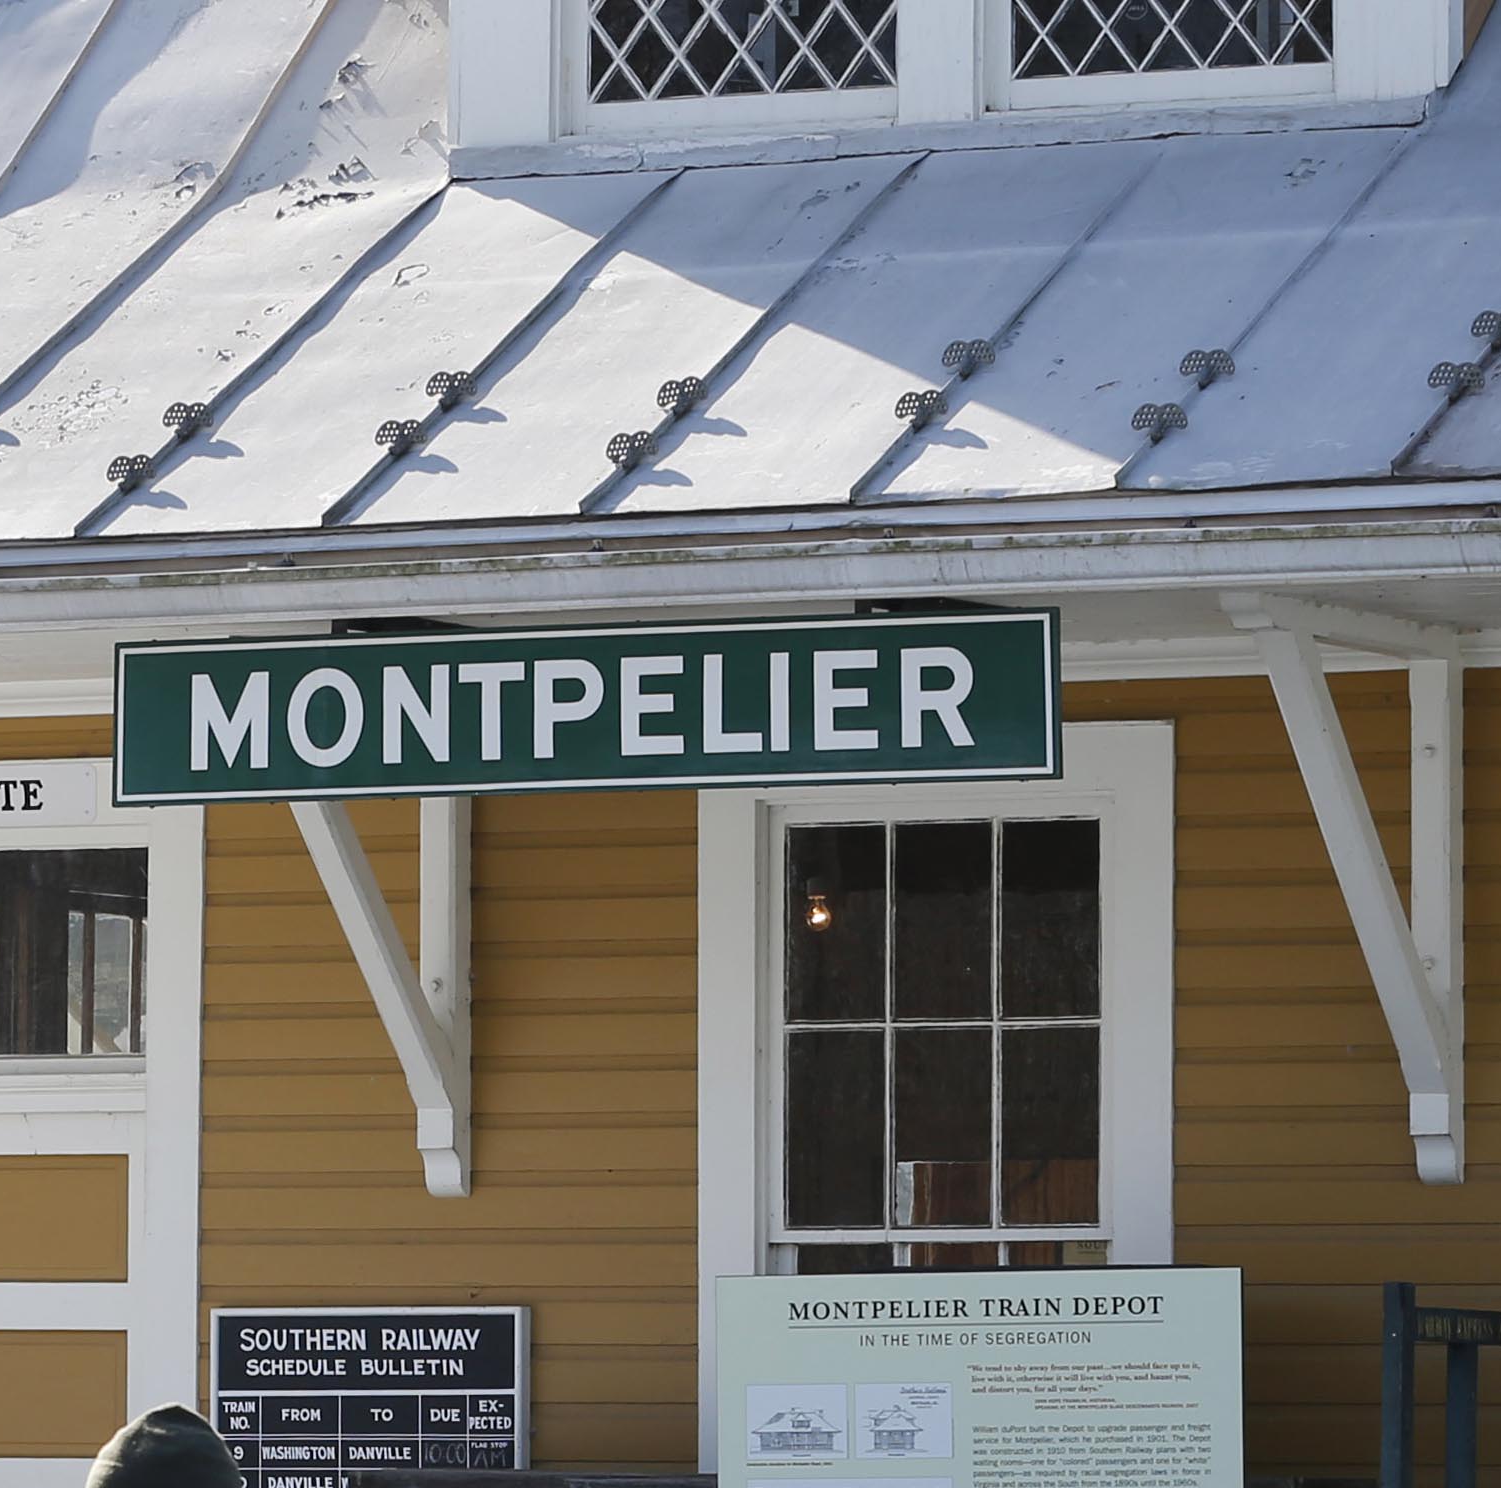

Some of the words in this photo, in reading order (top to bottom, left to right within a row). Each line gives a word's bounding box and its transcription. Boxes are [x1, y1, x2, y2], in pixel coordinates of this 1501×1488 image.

[189, 646, 975, 771] MONTPELIER
[788, 1299, 968, 1320] MONTPELIER
[979, 1298, 1062, 1317] TRAIN
[1073, 1296, 1164, 1316] DEPOT
[240, 1328, 366, 1352] SOUTHERN
[382, 1328, 480, 1350] RAILWAY
[859, 1334, 876, 1347] IN
[882, 1333, 911, 1346] THE
[917, 1332, 953, 1346] TIME
[960, 1332, 978, 1346] OF
[985, 1331, 1092, 1346] SEGREGATION
[246, 1359, 346, 1377] SCHEDULE
[361, 1359, 464, 1376] BULLETIN
[223, 1402, 255, 1414] TRAIN
[478, 1400, 504, 1412] EX-
[282, 1409, 321, 1422] FROM
[370, 1408, 393, 1422] TO
[430, 1409, 460, 1422] DUE
[230, 1417, 250, 1430] NO.
[469, 1416, 512, 1430] PECTED
[262, 1446, 335, 1460] WASHINGTON
[349, 1446, 412, 1460] DANVILLE
